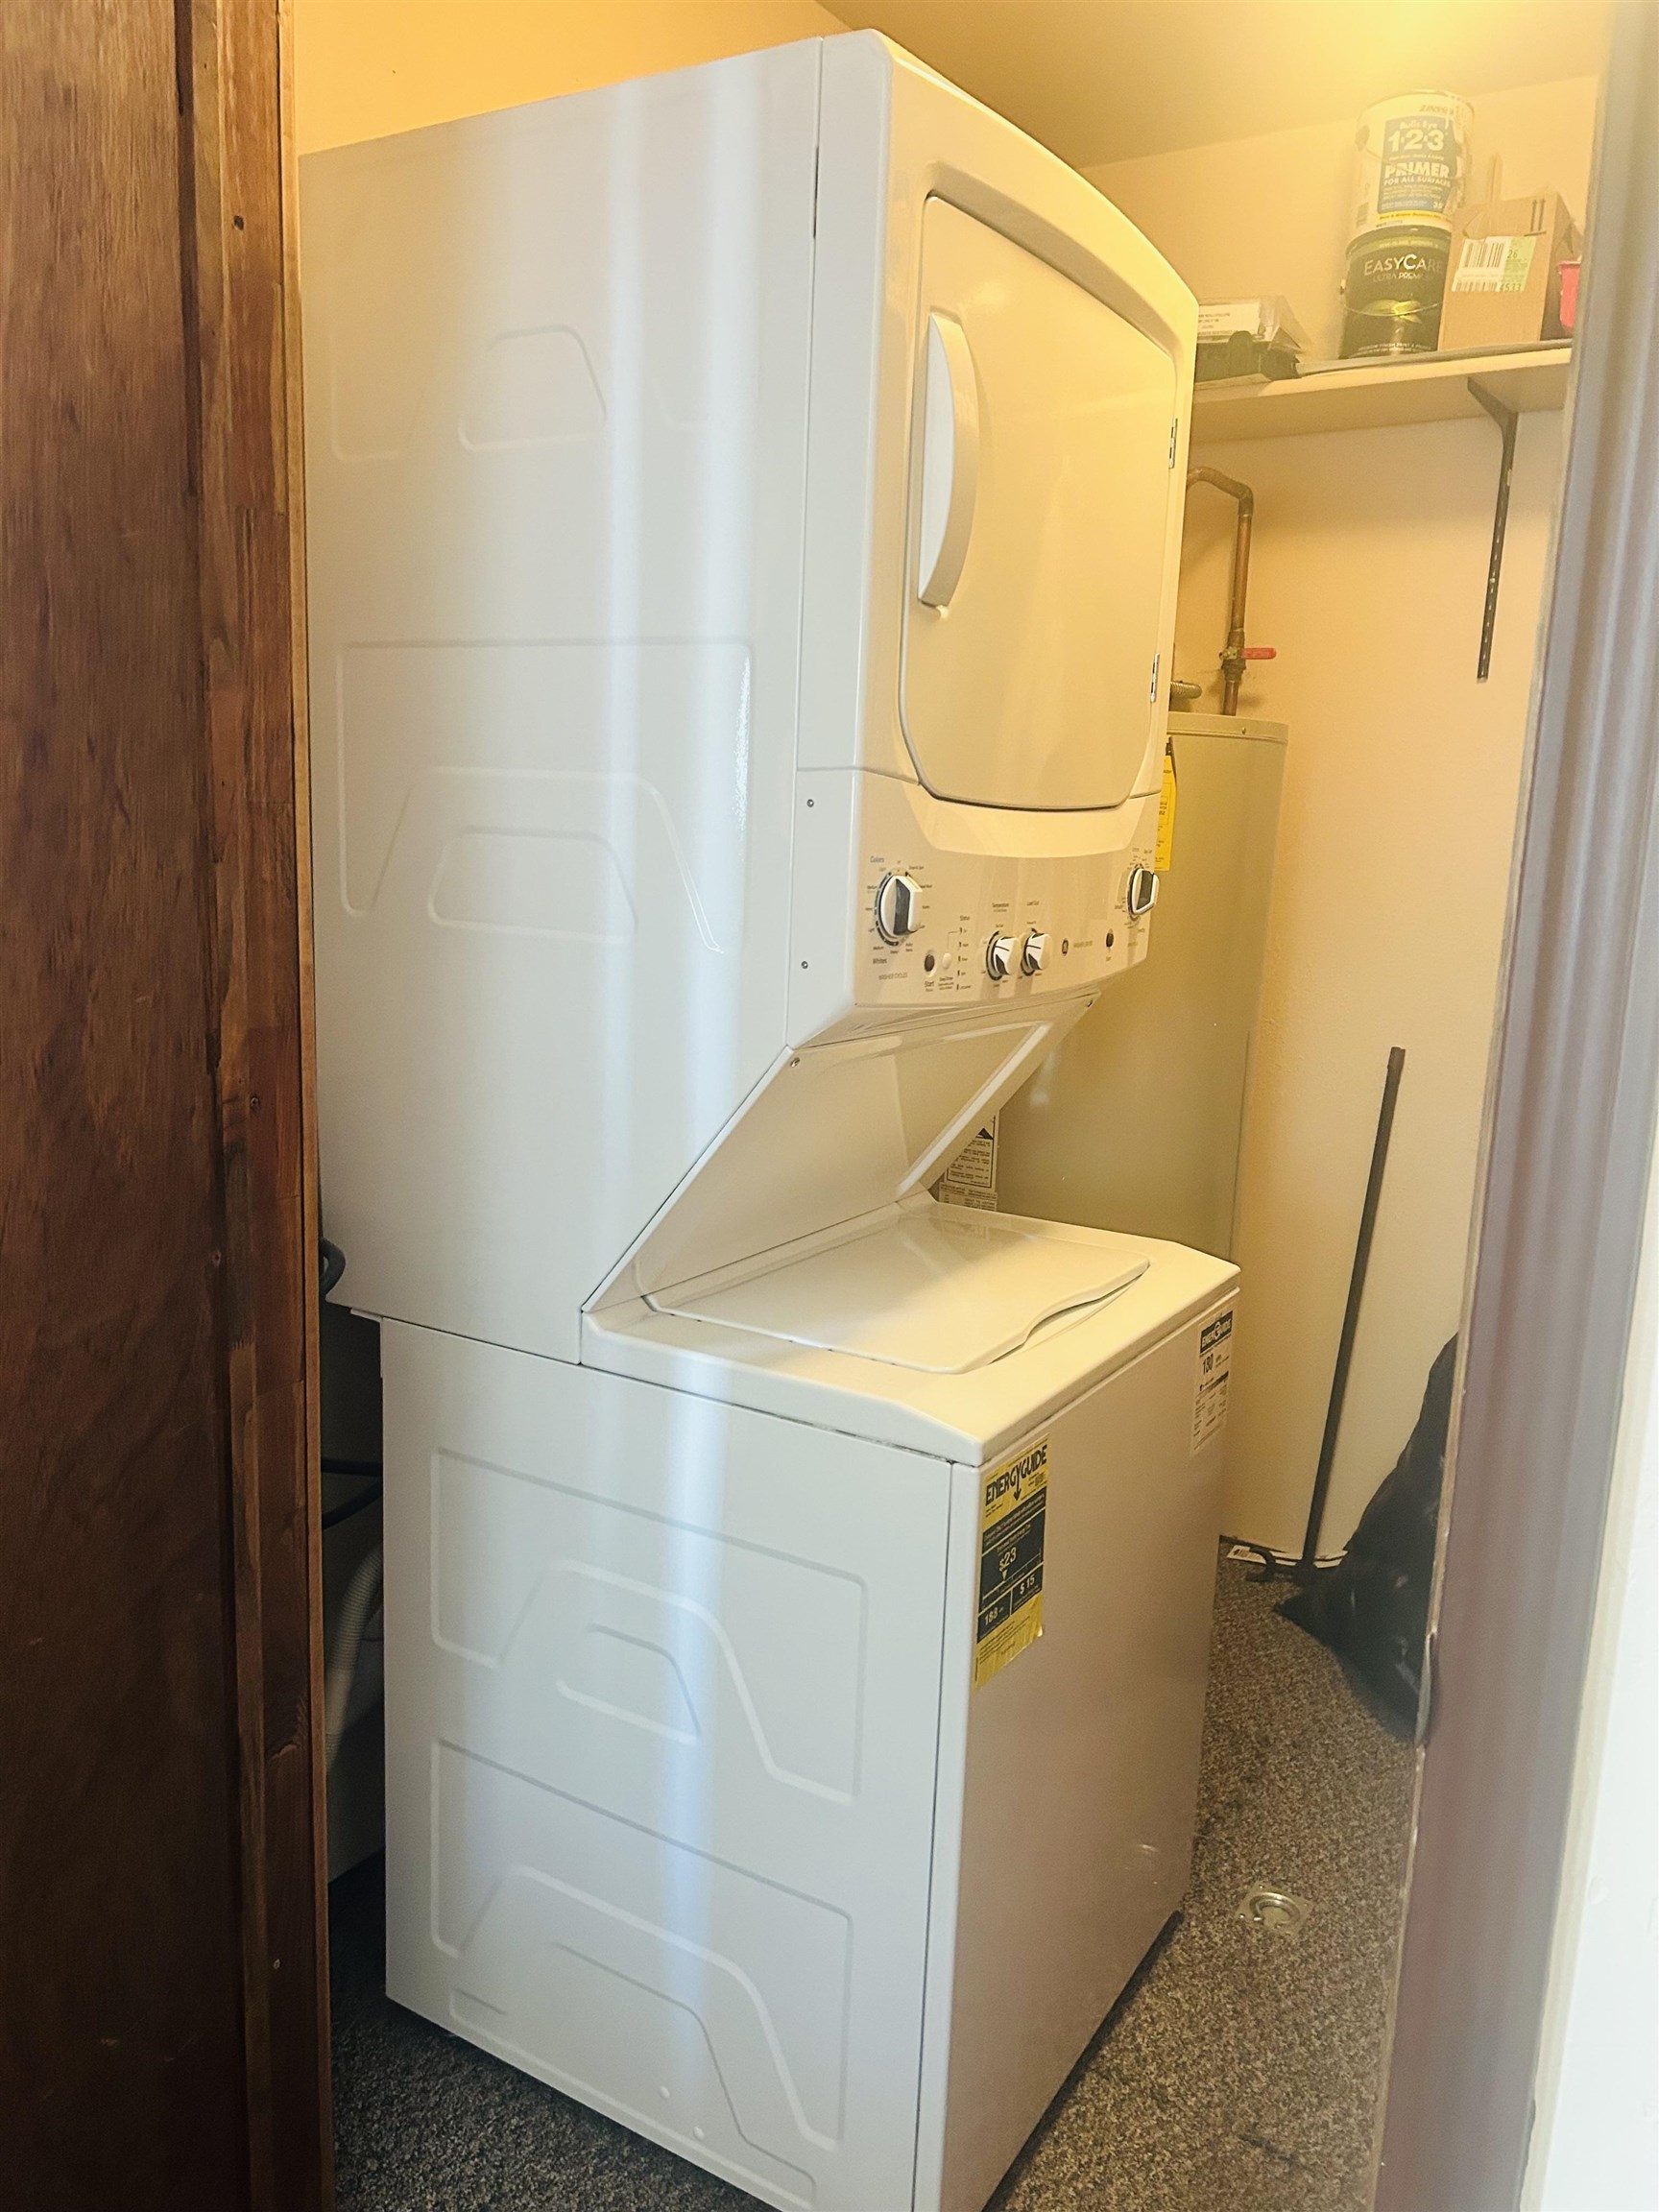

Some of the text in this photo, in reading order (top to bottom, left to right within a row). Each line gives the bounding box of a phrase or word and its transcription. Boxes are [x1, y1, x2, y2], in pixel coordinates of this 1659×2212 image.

[1384, 161, 1450, 179] PRIMER
[1383, 177, 1399, 185] FOR
[1417, 176, 1452, 187] SURFACES
[985, 1443, 1048, 1506] ENERGYGUIDE
[998, 1547, 1017, 1572] $23
